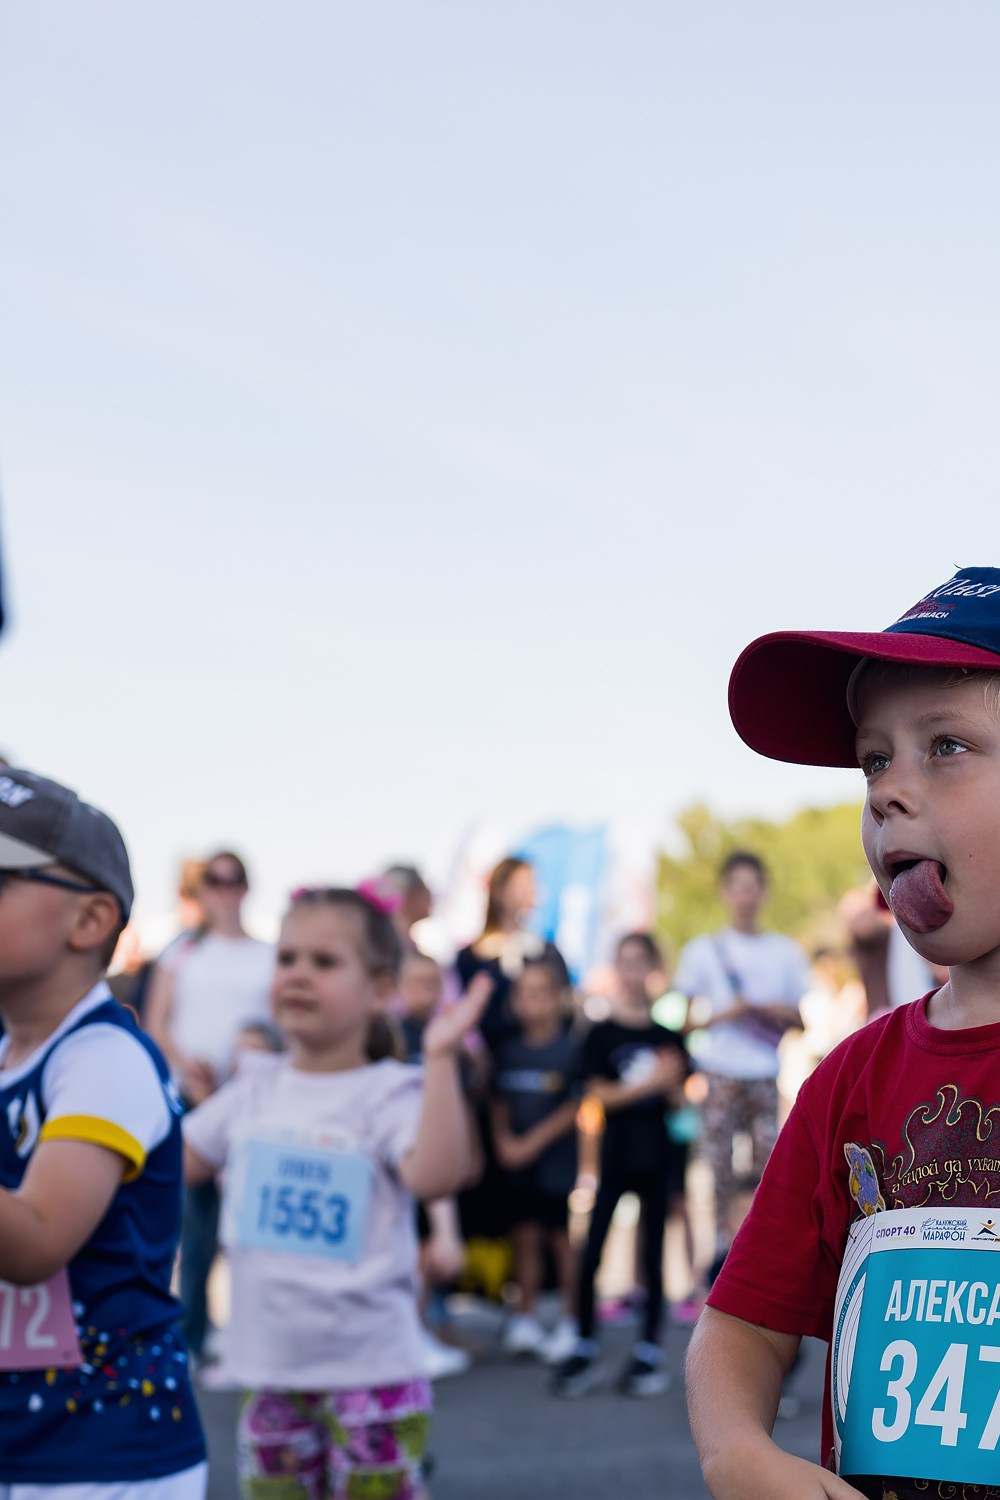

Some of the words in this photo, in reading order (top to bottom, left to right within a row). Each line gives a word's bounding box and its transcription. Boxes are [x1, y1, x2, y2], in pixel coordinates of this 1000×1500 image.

[257, 1184, 351, 1246] 1553
[875, 1226, 903, 1239] СПОРТ
[903, 1226, 916, 1236] 40
[922, 1231, 966, 1241] МАРАФОН
